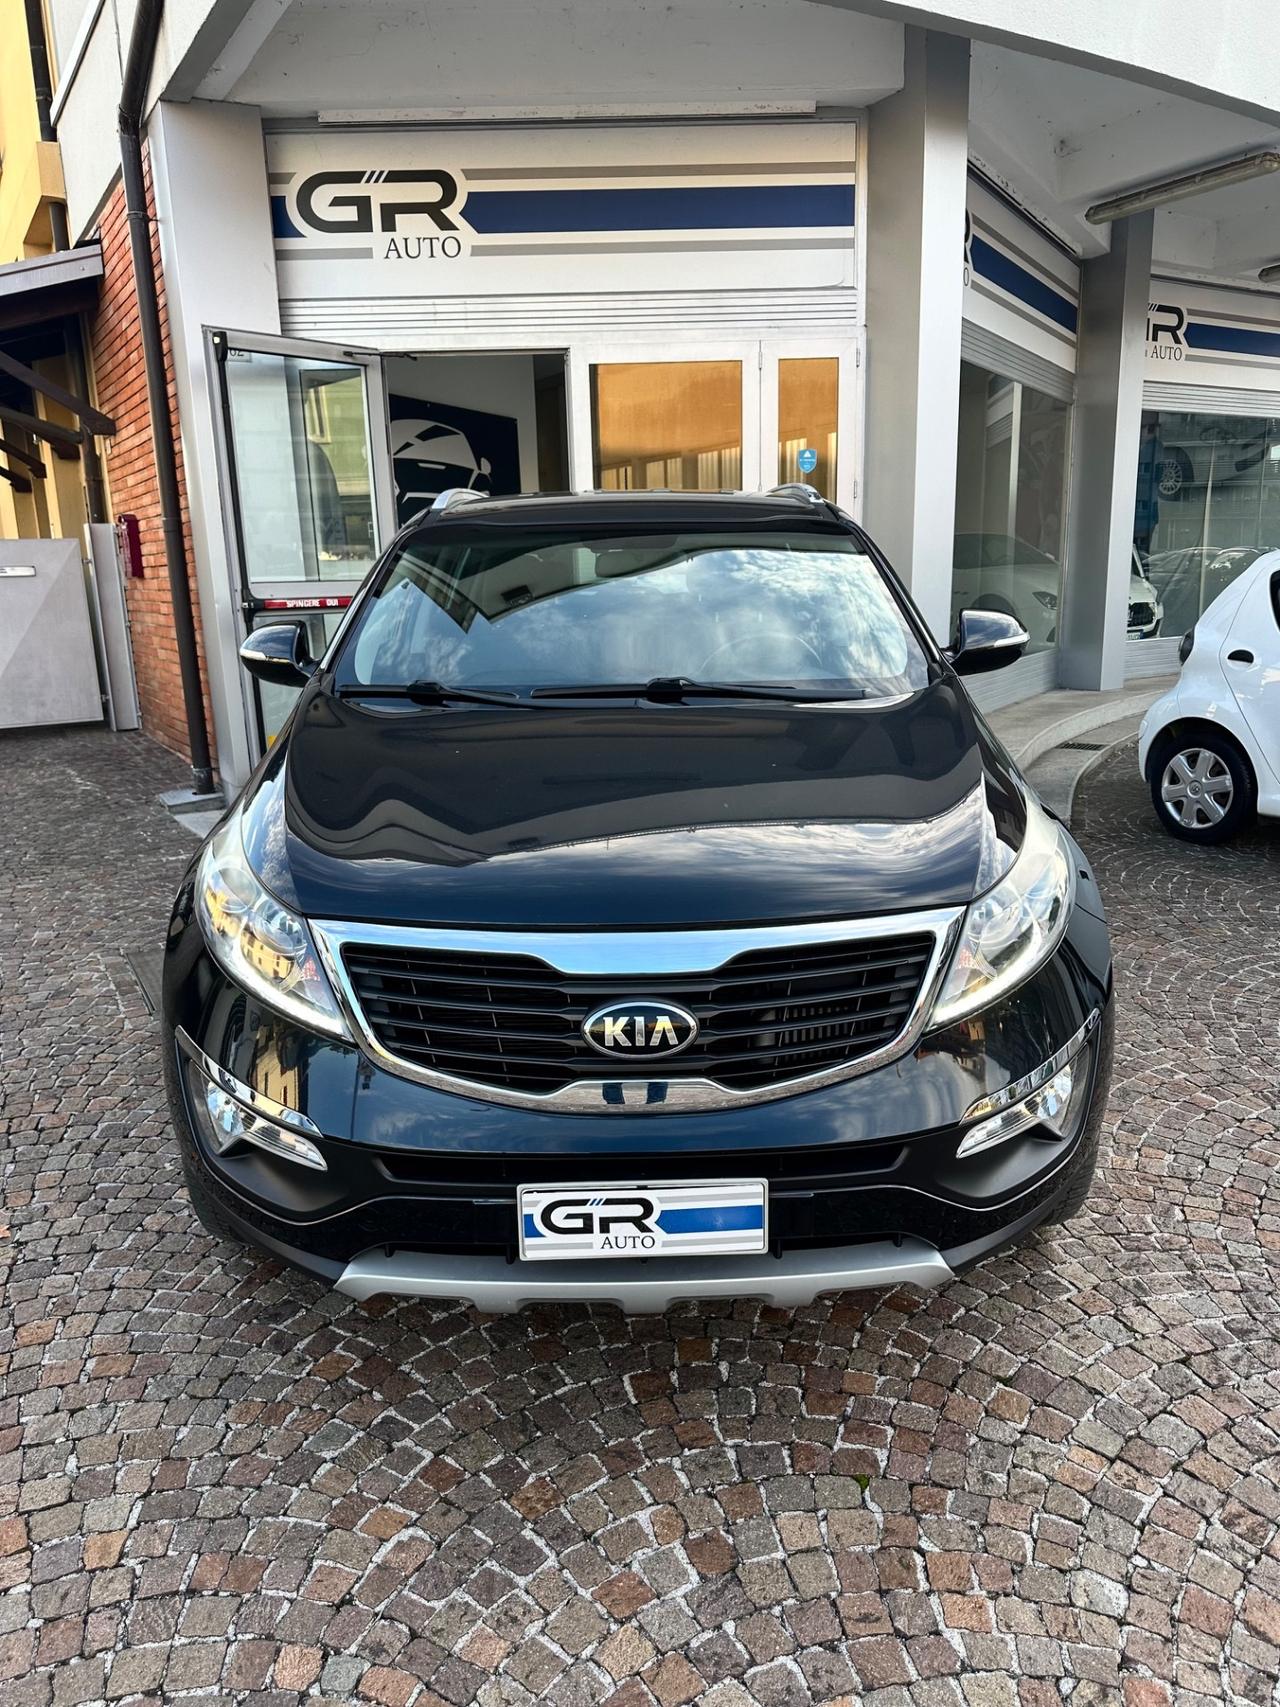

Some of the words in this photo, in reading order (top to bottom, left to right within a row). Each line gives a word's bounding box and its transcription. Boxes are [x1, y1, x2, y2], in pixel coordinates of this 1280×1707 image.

[296, 169, 460, 234] GR
[384, 236, 462, 260] AUTO
[1146, 303, 1184, 345] R
[1150, 345, 1183, 361] AUTO
[603, 1015, 679, 1047] KIA
[541, 1197, 655, 1235] GR
[601, 1235, 656, 1250] AUTO
